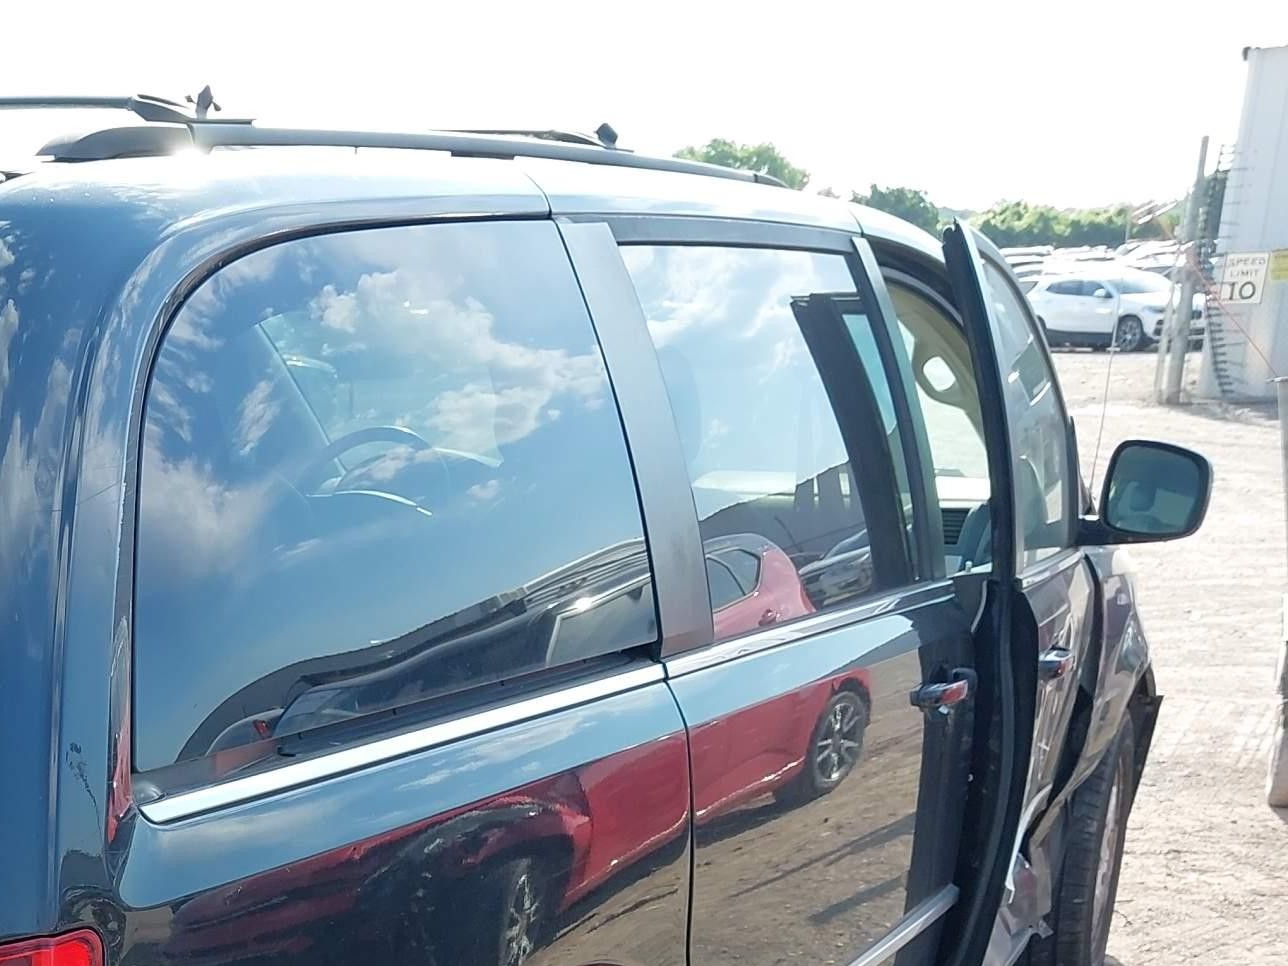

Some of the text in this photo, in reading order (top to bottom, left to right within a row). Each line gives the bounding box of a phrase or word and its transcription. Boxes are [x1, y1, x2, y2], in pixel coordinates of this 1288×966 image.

[1228, 256, 1267, 268] SPEED
[1229, 269, 1260, 278] LIMIT
[1227, 281, 1257, 301] 10
